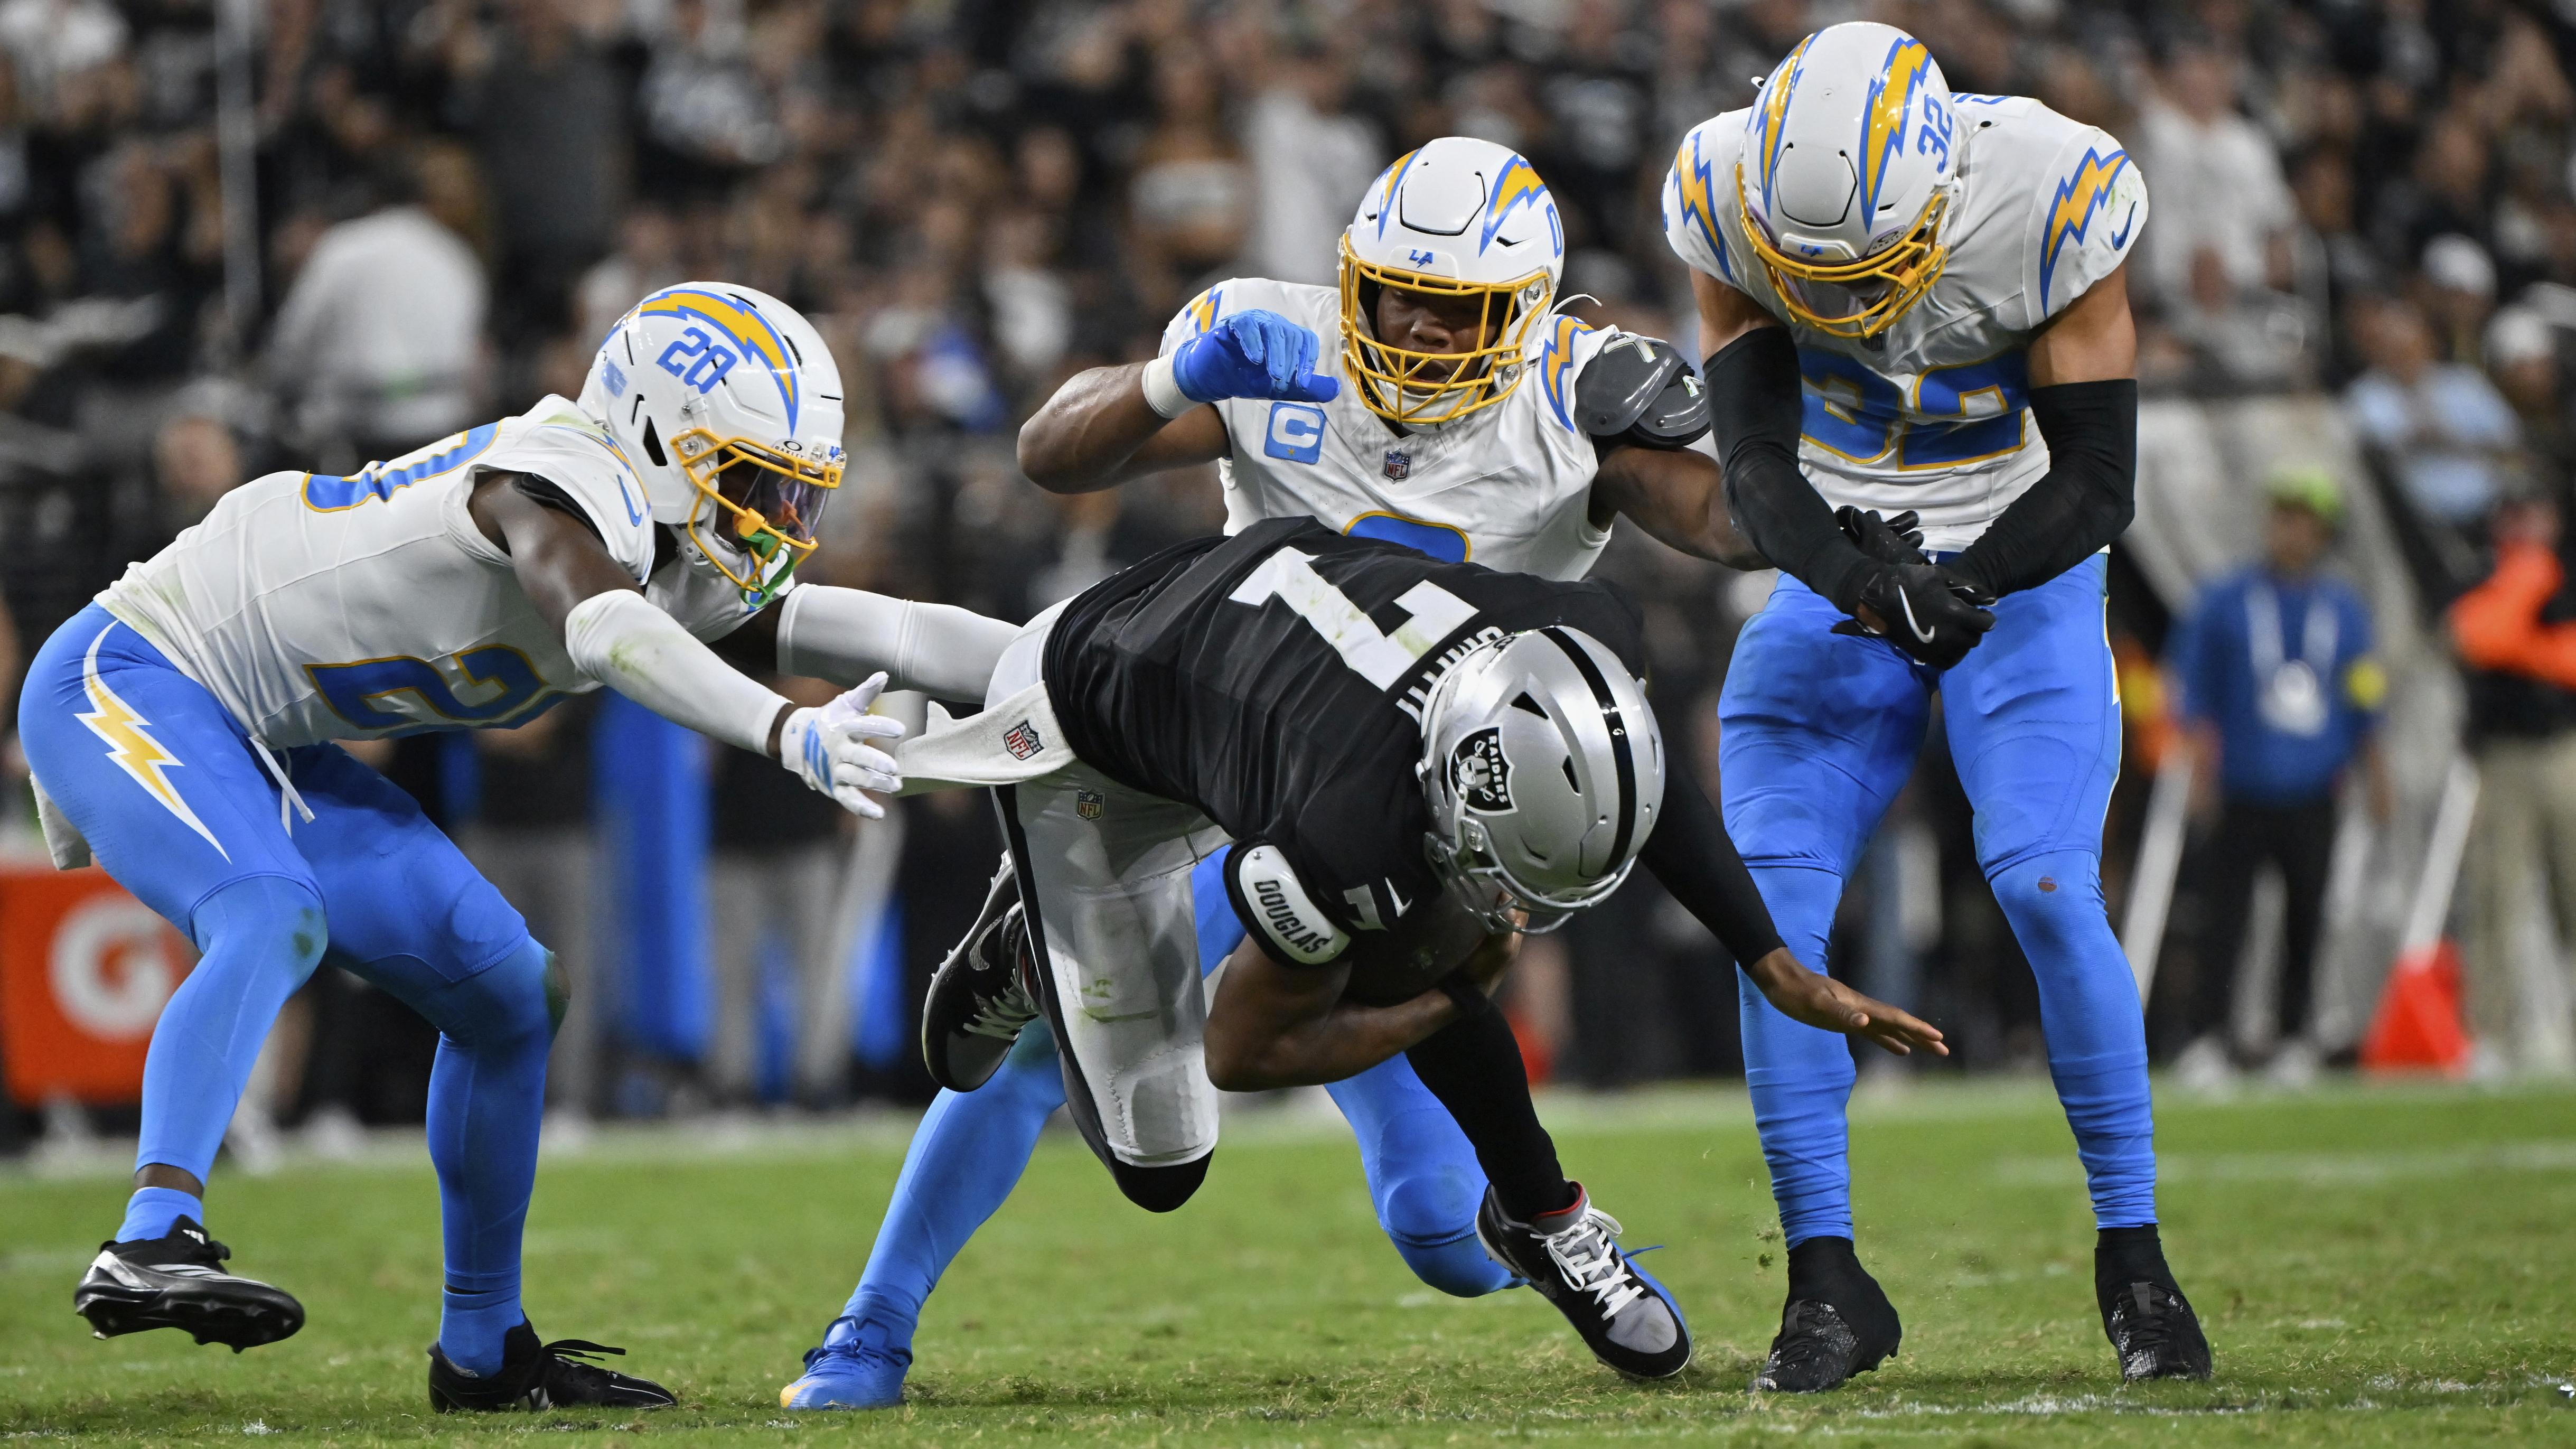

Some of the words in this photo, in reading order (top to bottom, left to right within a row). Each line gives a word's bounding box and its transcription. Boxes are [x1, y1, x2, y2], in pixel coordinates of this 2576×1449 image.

[1917, 93, 1953, 174] 32
[1409, 249, 1433, 268] LA
[1545, 203, 1562, 259] 0
[657, 326, 737, 394] 20
[1271, 407, 1322, 448] C
[1799, 346, 2031, 471] 32
[1387, 463, 1406, 476] NFL
[1228, 546, 1479, 692] 7
[1006, 730, 1031, 759] NFL
[1488, 735, 1508, 803] RAIDERS
[1079, 803, 1099, 817] NFL
[1253, 880, 1333, 953] DOUGLAS
